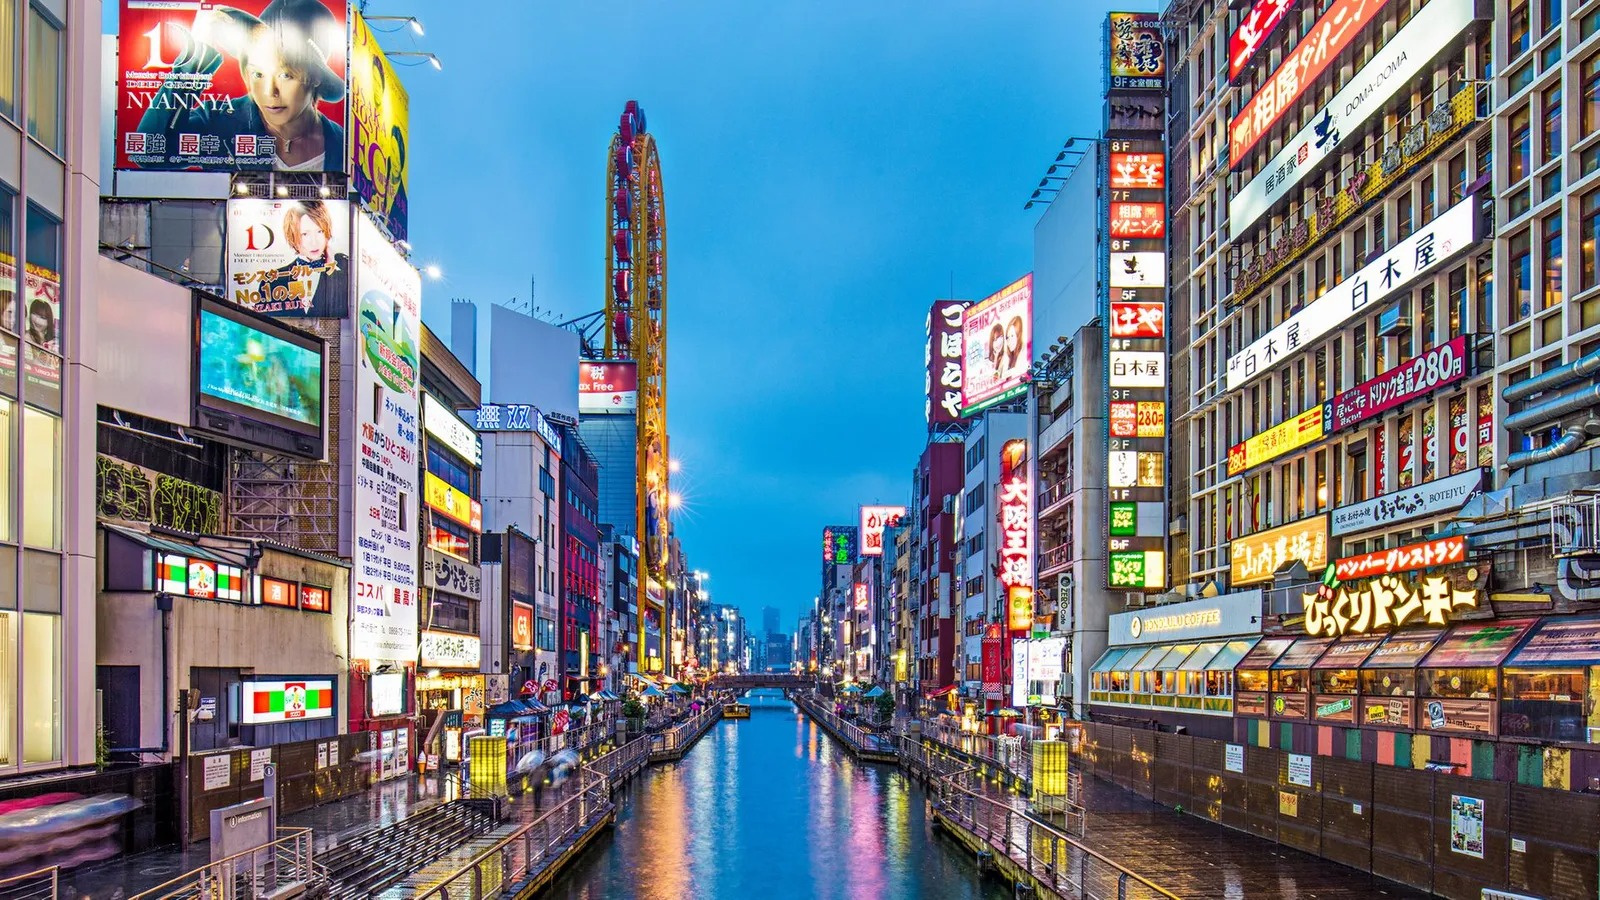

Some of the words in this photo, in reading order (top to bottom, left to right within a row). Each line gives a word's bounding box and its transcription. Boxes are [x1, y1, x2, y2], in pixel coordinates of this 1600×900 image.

[126, 82, 161, 90] DEEP
[163, 82, 213, 90] GROUP
[1113, 76, 1127, 88] 9F
[1344, 50, 1409, 118] DOMA-DOMA
[127, 92, 235, 114] NYANNYA
[126, 133, 166, 155] 最強
[179, 133, 220, 155] 最幸
[235, 134, 277, 157] 最高
[1112, 141, 1130, 152] 8F
[1112, 161, 1162, 188] 笑笑
[1112, 191, 1130, 202] 7F
[1119, 205, 1143, 219] 相席
[1111, 218, 1164, 235] ダイニング
[1112, 240, 1131, 251] 6F
[233, 261, 341, 286] モンスターグループ
[1351, 232, 1438, 312] 白木屋
[1121, 290, 1138, 301] 5F
[968, 306, 1001, 337] 高収入
[1112, 305, 1164, 335] はや
[1112, 339, 1131, 351] 4F
[1244, 320, 1302, 378] 白木屋
[1113, 358, 1161, 377] 白木屋
[1369, 345, 1462, 409] ドリンク全品280円
[579, 382, 591, 392] ax
[592, 381, 614, 392] Free
[1112, 390, 1130, 401] 3F
[1138, 411, 1164, 426] 280円
[1112, 440, 1130, 450] 2F
[1112, 490, 1131, 500] 1F
[1429, 485, 1467, 504] BOTEJYU
[1000, 477, 1029, 586] 大阪王将
[1111, 539, 1131, 551] B1F
[1335, 540, 1463, 577] ハンバーグレストラン
[357, 582, 383, 601] コスパ
[1060, 588, 1068, 609] ZERO
[1302, 575, 1477, 637] びっくりドンキー
[1144, 616, 1185, 633] HONOLULU
[1186, 609, 1220, 628] COFFEE
[237, 811, 263, 824] information
